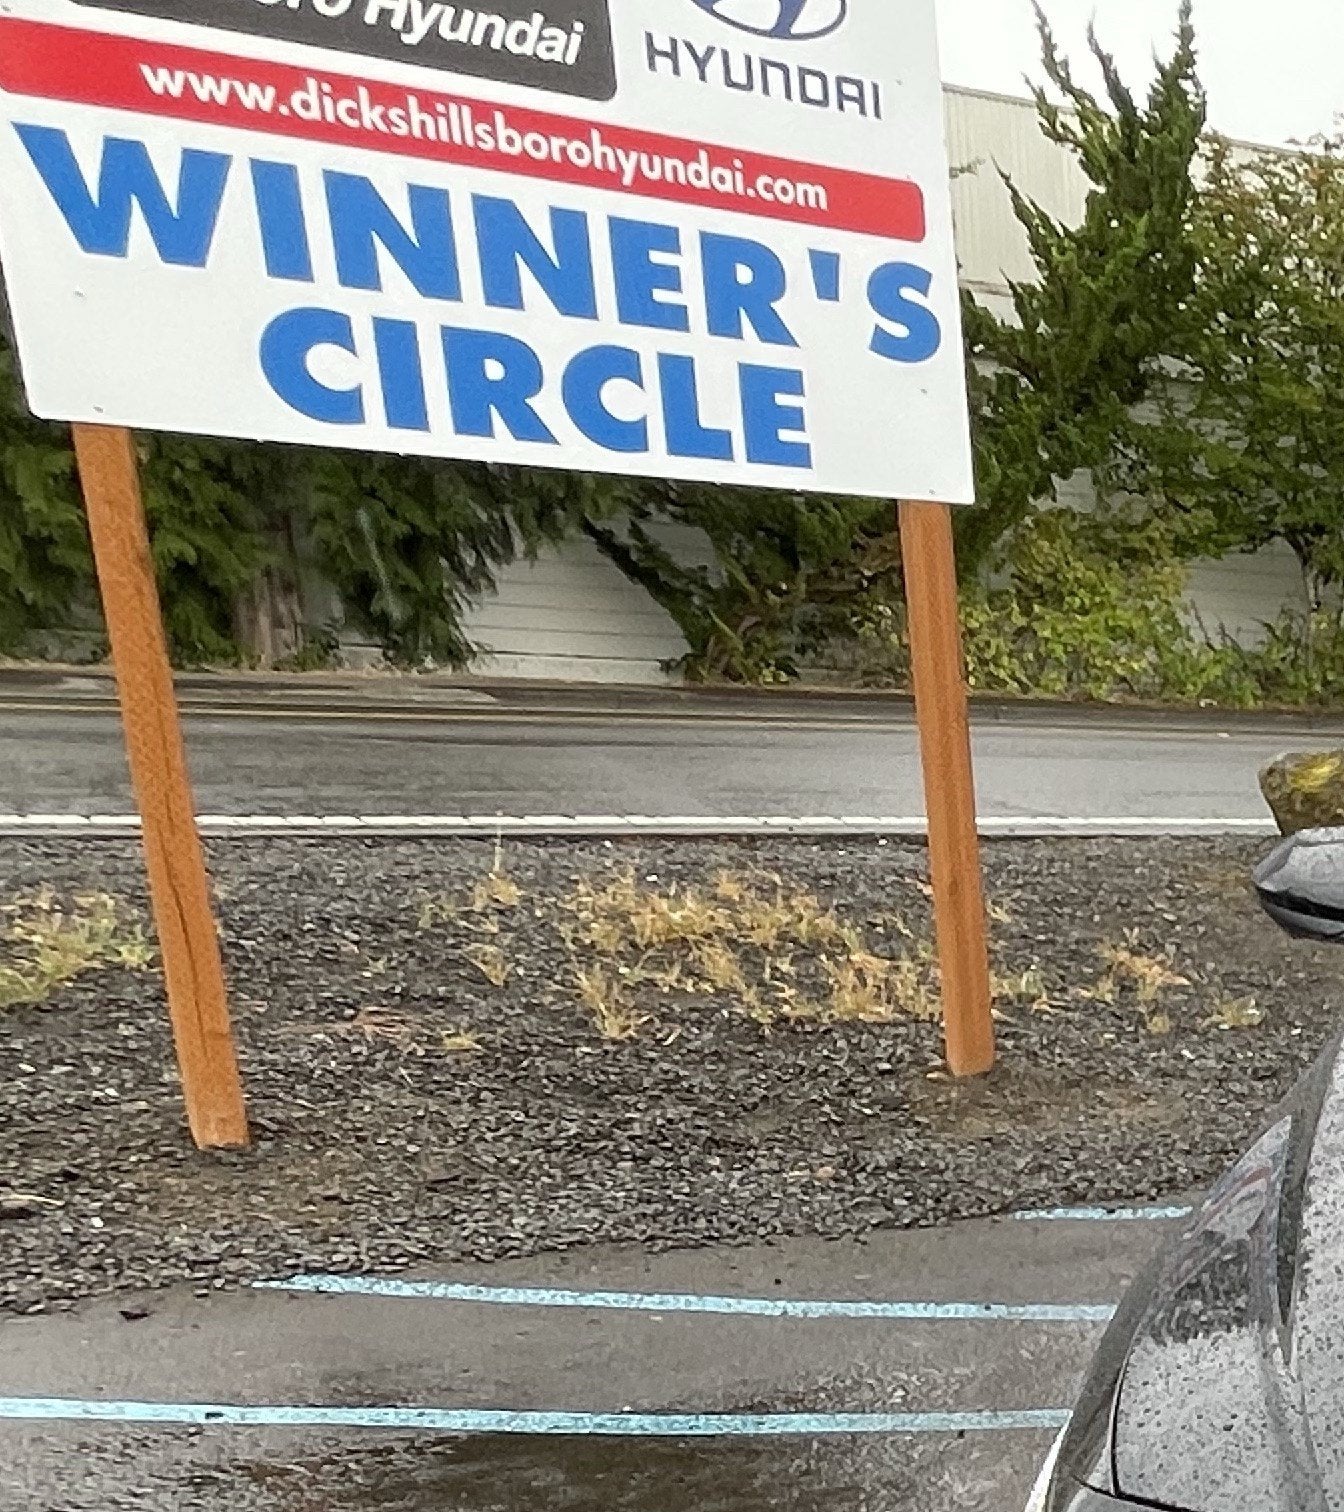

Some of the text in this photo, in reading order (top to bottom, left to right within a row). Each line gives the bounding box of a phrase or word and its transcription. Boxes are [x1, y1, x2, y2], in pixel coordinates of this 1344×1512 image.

[364, 0, 584, 66] Hyundai
[645, 32, 882, 120] HYUNDAI
[139, 62, 829, 212] www.dickshillsborohyundai.com
[12, 121, 942, 364] WINNER'S
[260, 306, 813, 470] CIRCLE
